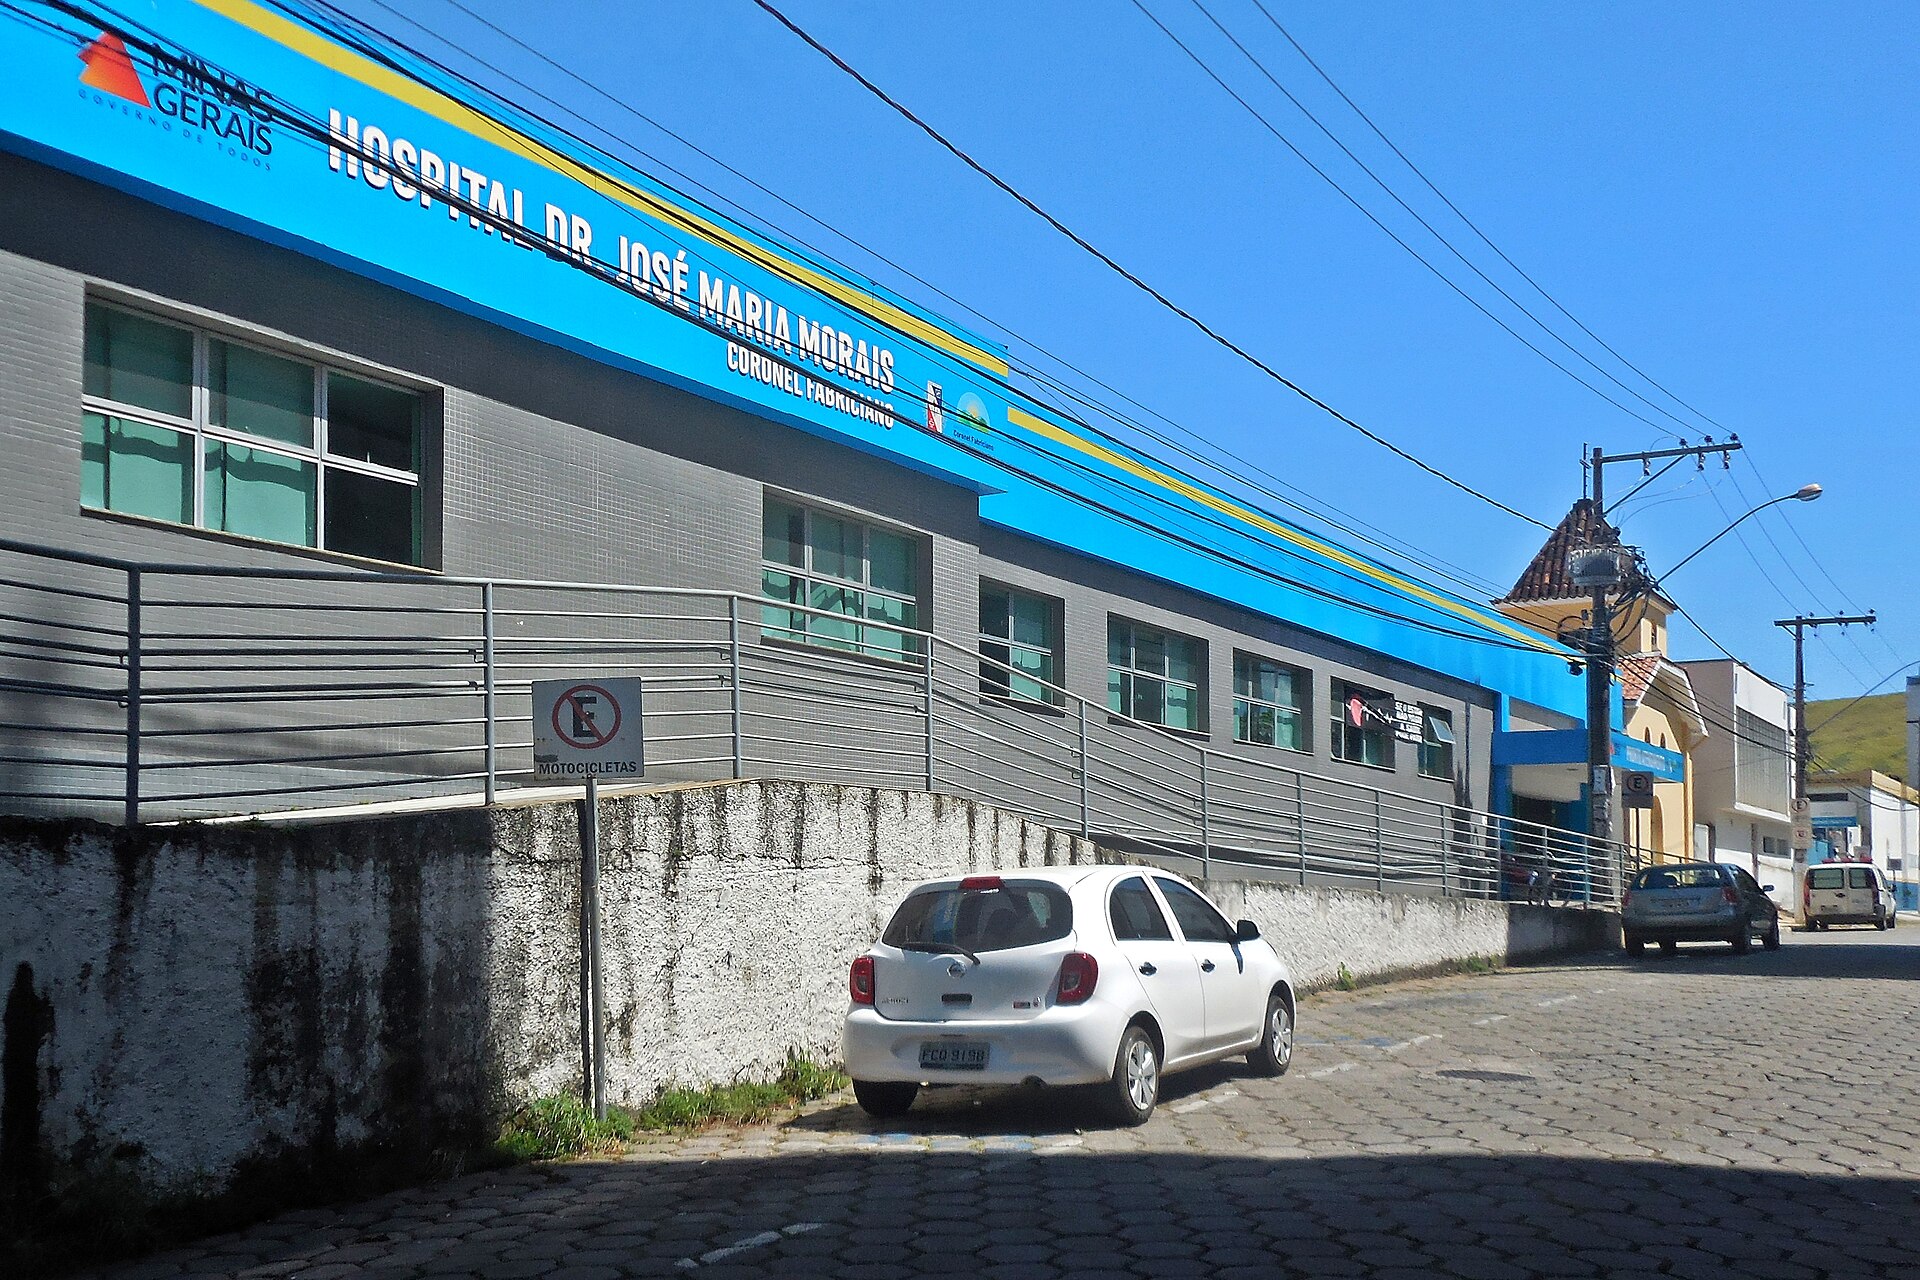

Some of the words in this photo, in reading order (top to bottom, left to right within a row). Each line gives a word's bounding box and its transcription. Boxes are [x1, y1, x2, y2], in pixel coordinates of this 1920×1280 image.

[78, 89, 172, 131] GOVERNO
[182, 130, 203, 144] DE
[216, 142, 272, 172] TODOS
[154, 82, 272, 156] GERAIS
[329, 108, 533, 251] HOSPITAL
[616, 235, 690, 313] JOSÉ
[698, 271, 792, 357] MARIA
[798, 314, 895, 394] MORAIS
[727, 342, 803, 397] CORONEL
[806, 377, 895, 429] FABRICIANO
[539, 761, 637, 775] MOTOCICLETAS
